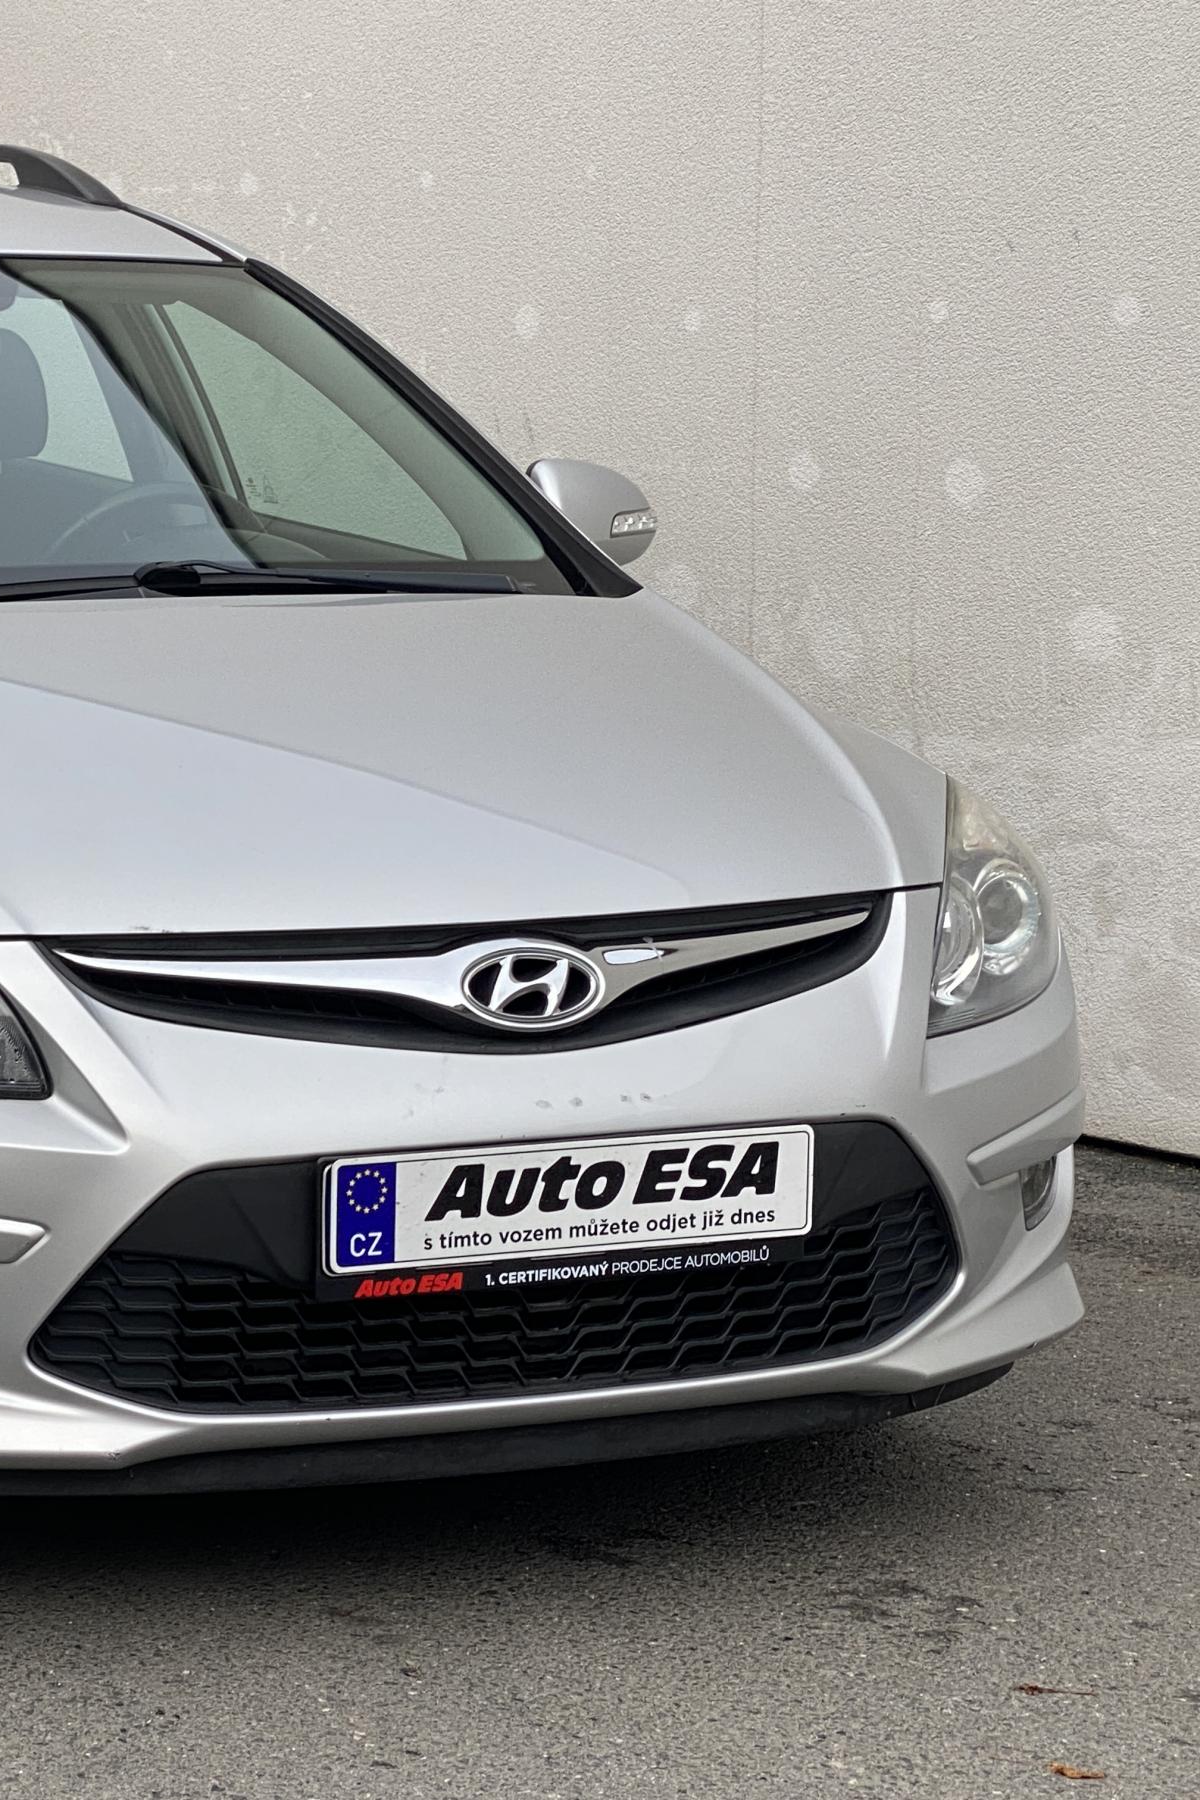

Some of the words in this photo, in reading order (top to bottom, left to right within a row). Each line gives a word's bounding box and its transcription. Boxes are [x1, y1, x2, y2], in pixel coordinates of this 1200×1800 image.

[424, 1156, 625, 1221] Auto
[632, 1141, 780, 1205] ESA
[350, 1231, 382, 1258] CZ
[423, 1236, 433, 1251] s
[439, 1230, 492, 1249] tímto
[499, 1226, 562, 1244] vozem
[569, 1217, 640, 1239] můžete
[646, 1213, 697, 1232] odjet
[701, 1210, 724, 1230] již
[730, 1208, 776, 1225] dnes
[354, 1277, 415, 1298] Auto
[417, 1272, 464, 1293] ESA
[485, 1273, 495, 1286] 1.
[498, 1261, 609, 1285] CERTIFIKOVANÝ
[612, 1256, 682, 1275] PRODEJCE
[686, 1245, 770, 1267] AUTOMOBILŮ
